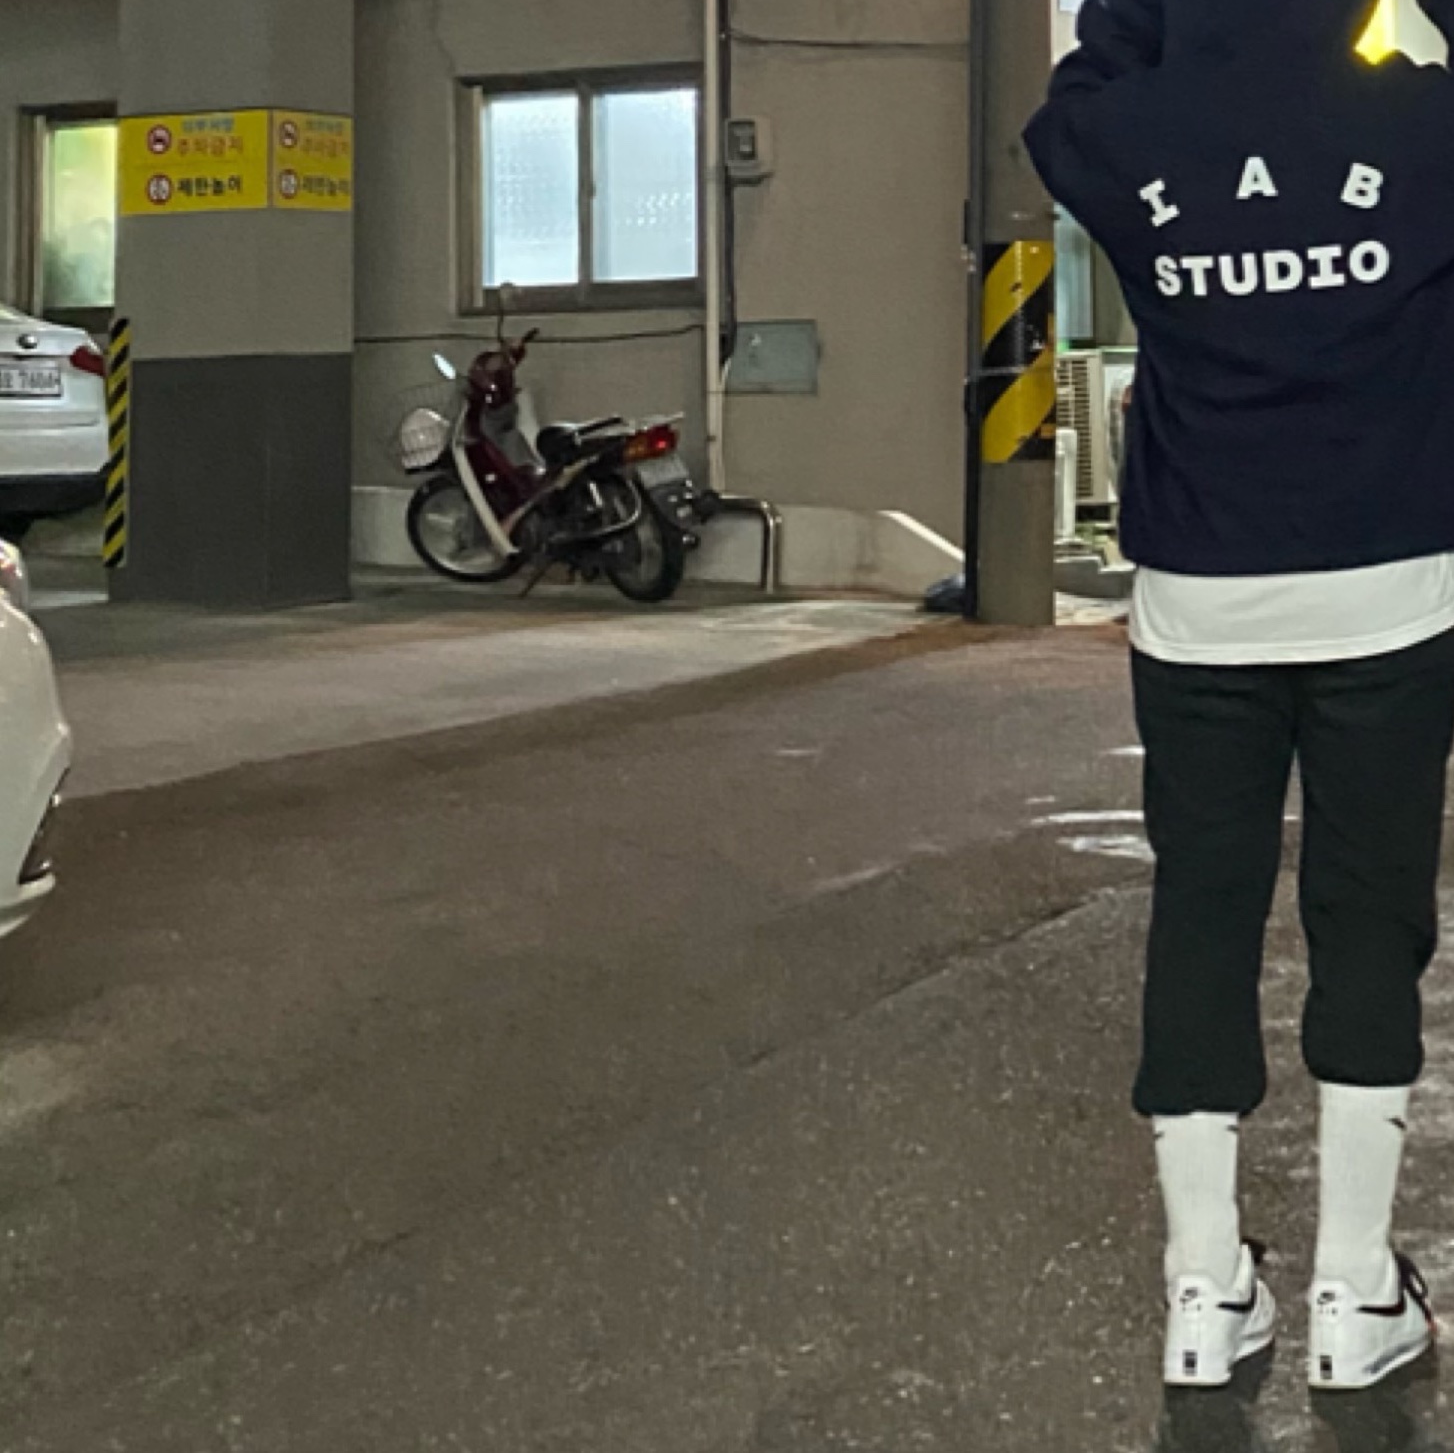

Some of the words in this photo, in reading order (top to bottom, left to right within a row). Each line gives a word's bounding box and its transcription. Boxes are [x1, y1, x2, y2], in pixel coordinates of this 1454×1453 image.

[1137, 177, 1181, 228] I
[1235, 154, 1279, 200] A
[1340, 161, 1384, 210] B
[1154, 239, 1391, 298] STUDIO
